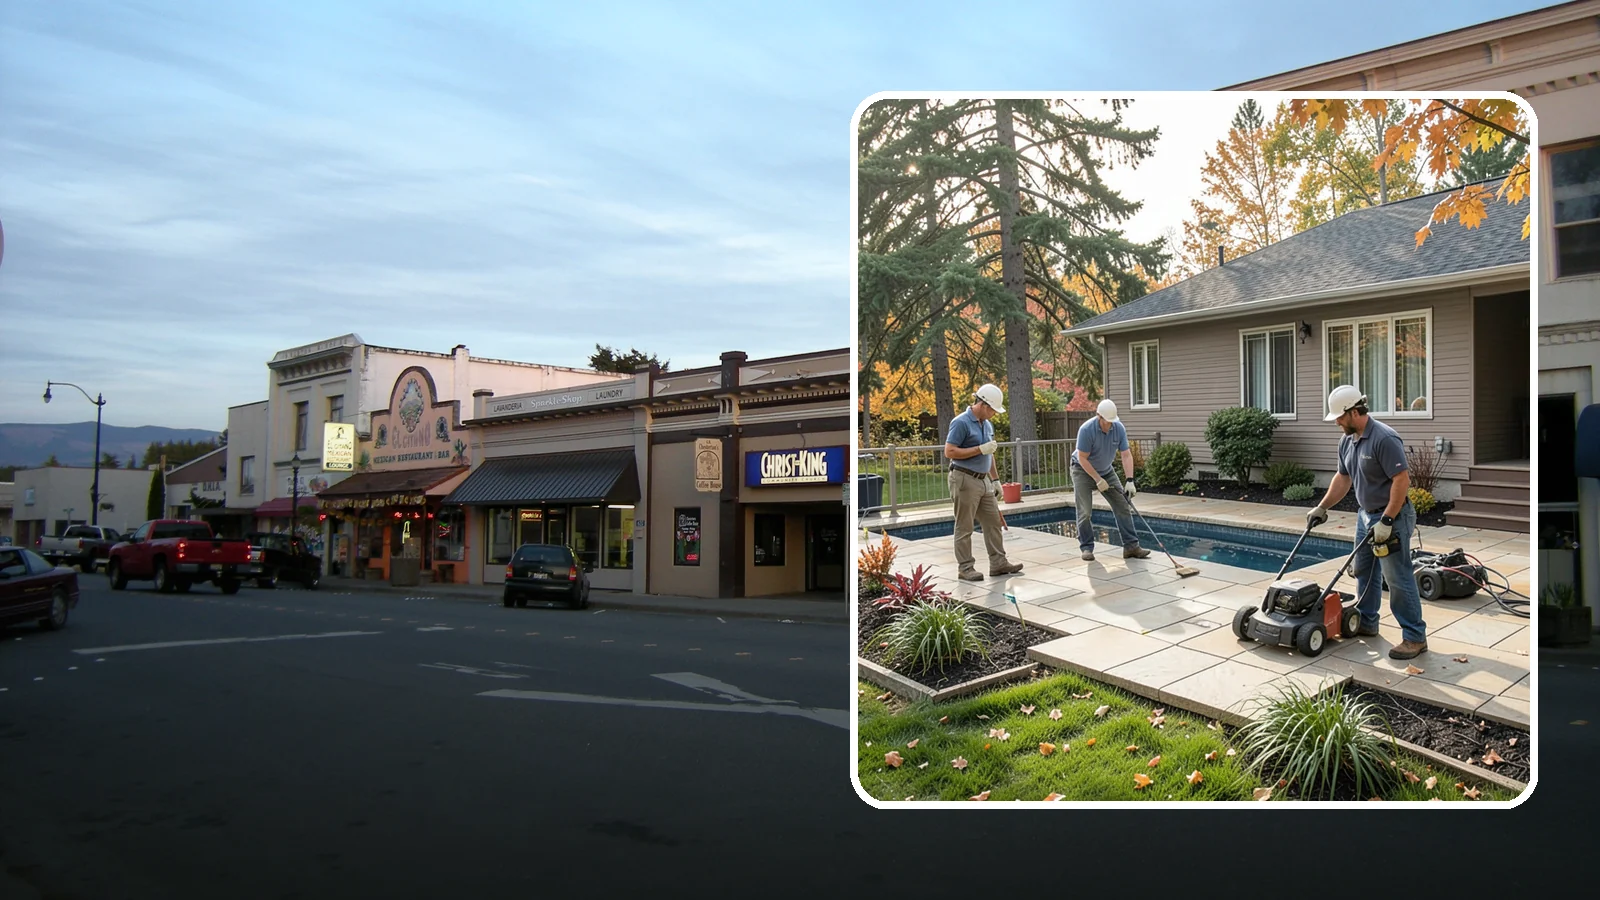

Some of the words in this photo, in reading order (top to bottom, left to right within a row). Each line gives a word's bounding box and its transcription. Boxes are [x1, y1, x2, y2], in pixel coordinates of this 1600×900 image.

[595, 389, 623, 399] LAUNDRY
[494, 402, 522, 412] LAVANDERIA
[531, 397, 561, 409] Sparkle
[562, 394, 582, 404] Shop
[373, 454, 396, 464] MEXICAN
[397, 452, 433, 462] RESTAURANT
[438, 450, 450, 459] BAR
[761, 452, 797, 478] CHRIST
[799, 450, 828, 476] KING
